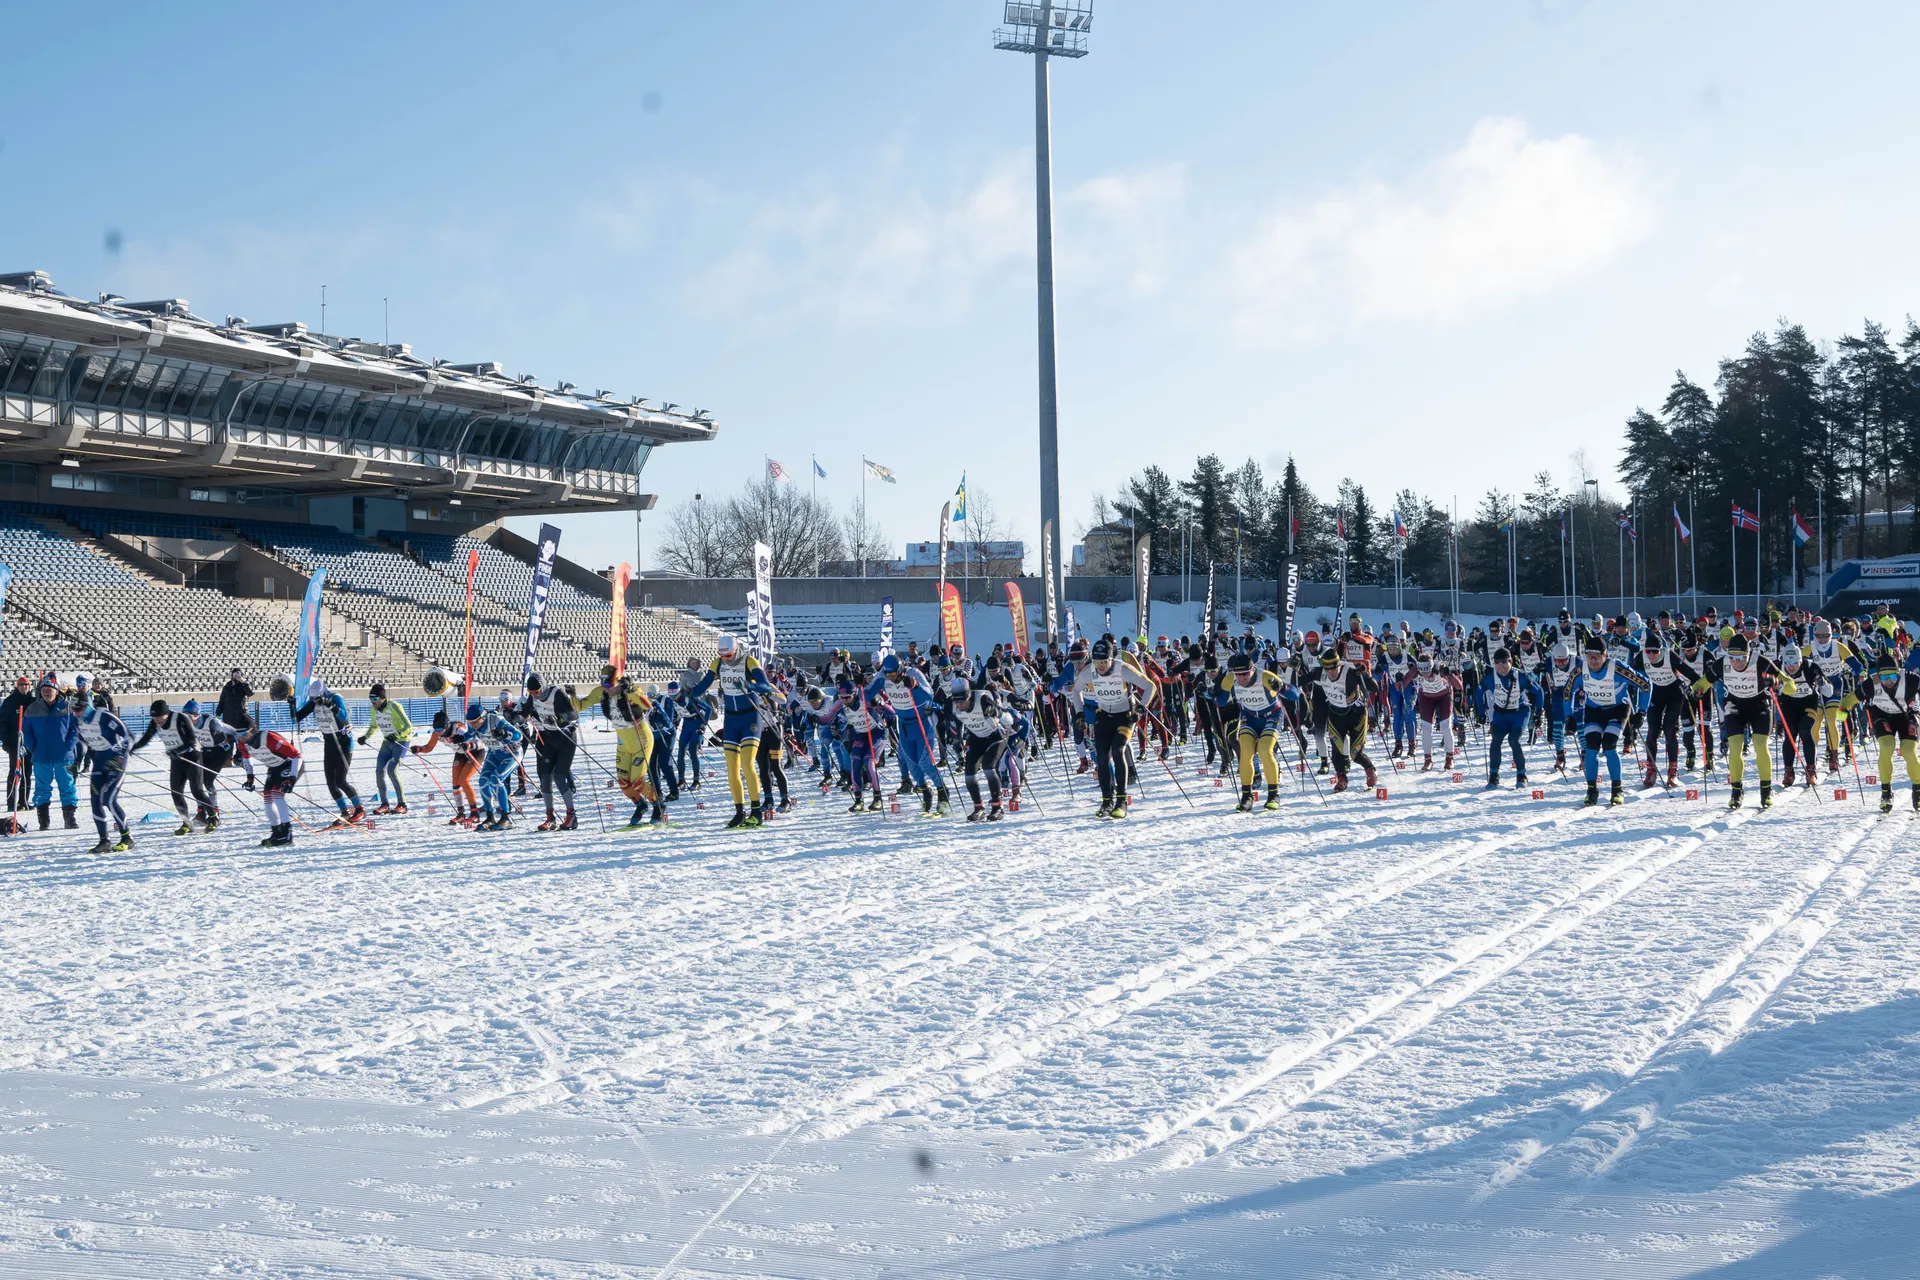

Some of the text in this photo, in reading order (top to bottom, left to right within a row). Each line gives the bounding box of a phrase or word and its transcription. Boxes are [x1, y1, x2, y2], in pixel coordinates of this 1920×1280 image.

[1870, 566, 1917, 575] INTERSPORT
[1046, 533, 1058, 636] SALOMON
[1097, 689, 1122, 697] 6006
[1397, 761, 1406, 769] 37
[1453, 774, 1462, 782] 20
[1867, 776, 1876, 784] 17
[1379, 790, 1384, 799] 4
[1535, 791, 1541, 799] 3
[1688, 790, 1694, 799] 2
[1011, 802, 1017, 810] 7
[766, 811, 772, 819] 9
[367, 821, 375, 829] 13
[464, 821, 473, 829] 12
